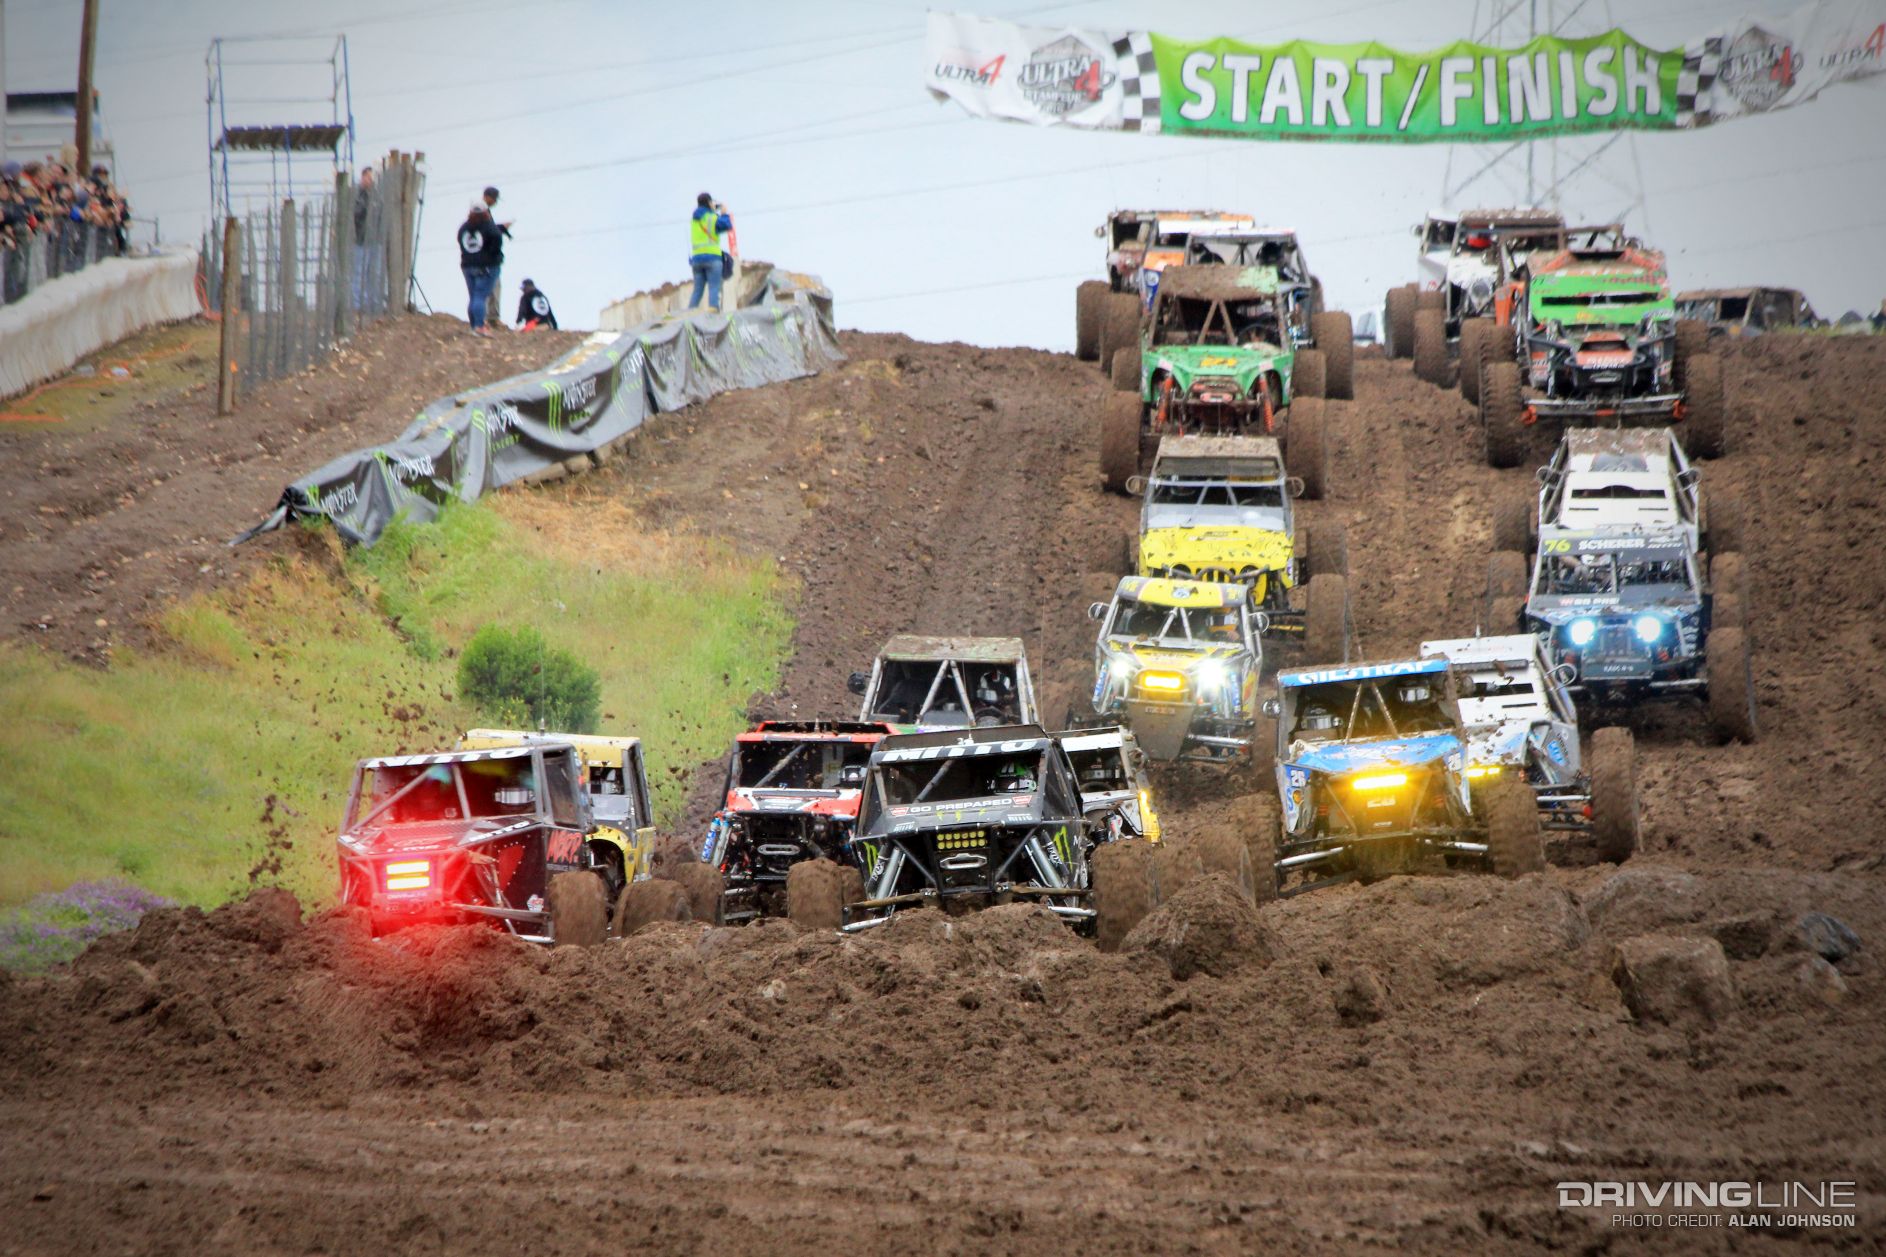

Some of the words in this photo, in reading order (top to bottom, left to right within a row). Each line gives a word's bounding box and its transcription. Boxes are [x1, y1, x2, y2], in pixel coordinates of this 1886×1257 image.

[1544, 539, 1572, 553] 76
[882, 740, 1036, 762] NITTO
[910, 805, 932, 813] GO
[936, 798, 1012, 811] PREPARED
